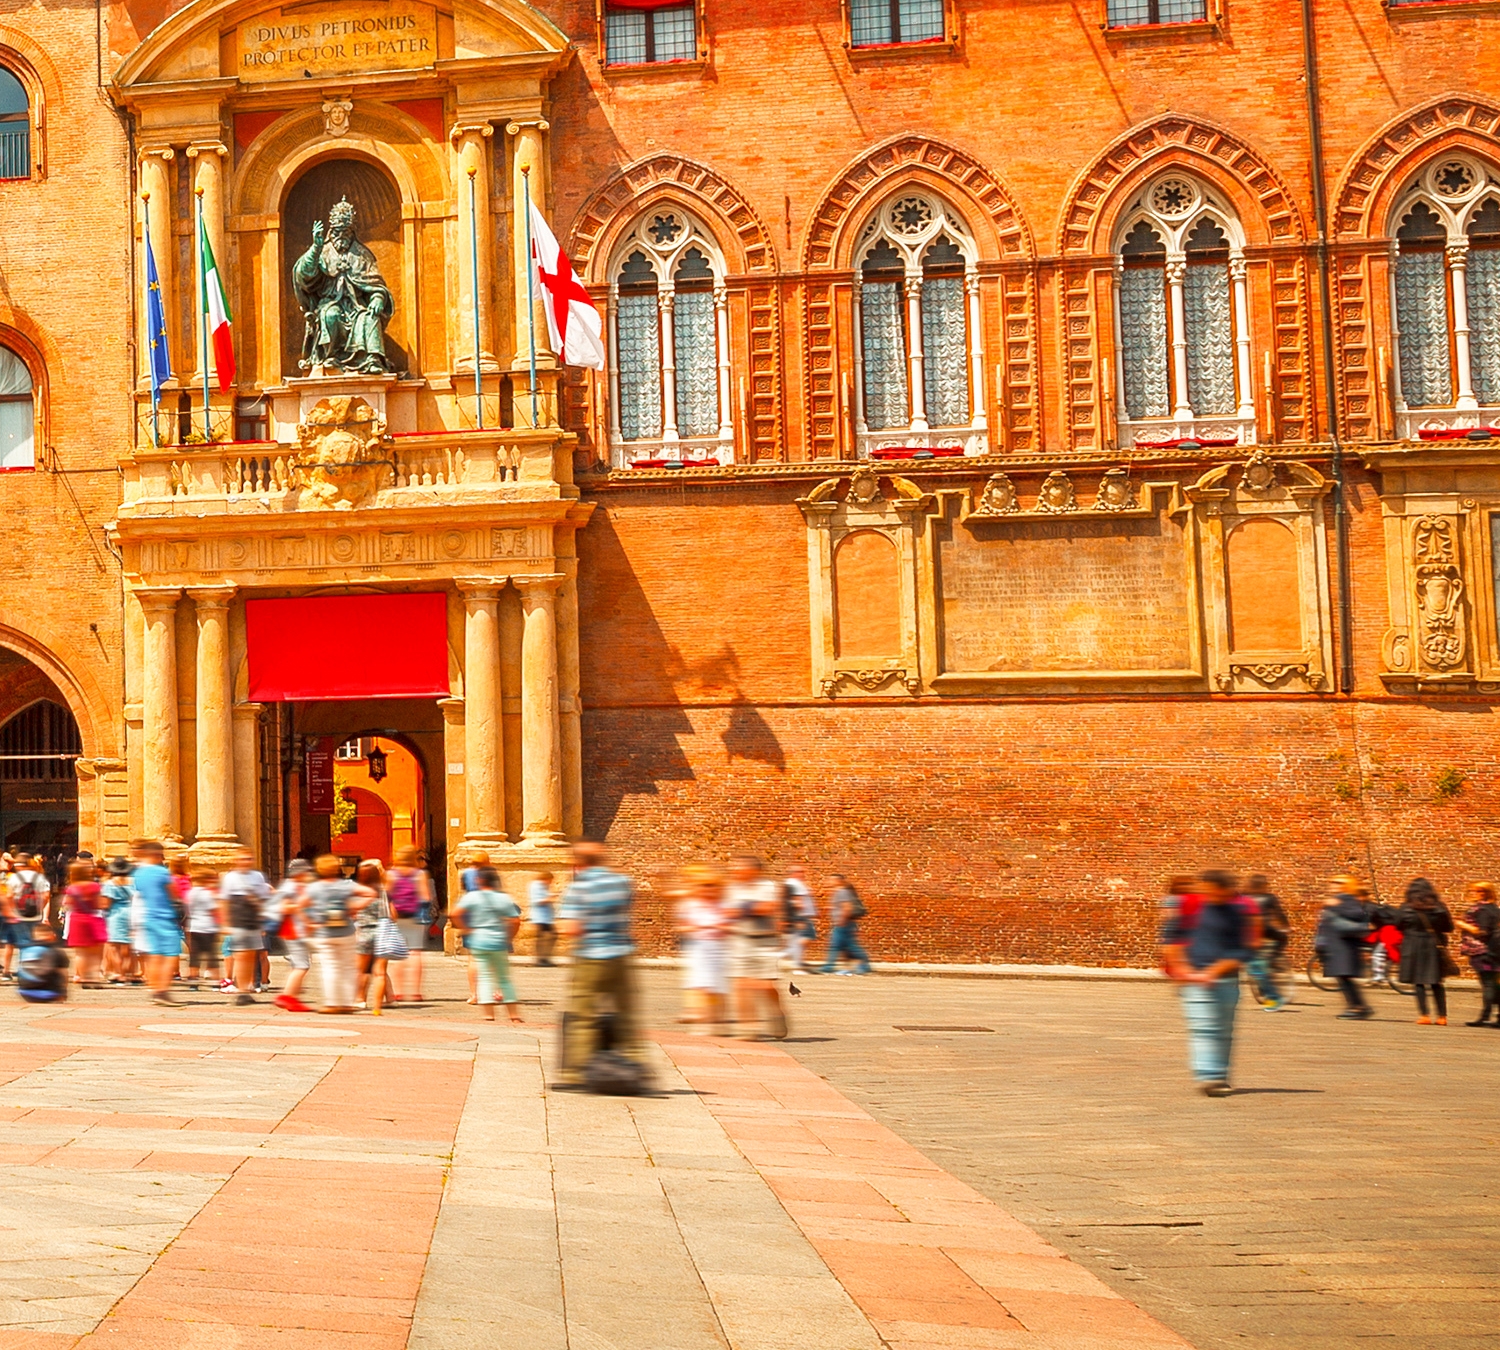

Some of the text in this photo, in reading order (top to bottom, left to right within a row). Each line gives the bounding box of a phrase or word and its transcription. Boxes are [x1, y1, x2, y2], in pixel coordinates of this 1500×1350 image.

[258, 14, 416, 42] DIVUS PETRONIUS
[243, 37, 430, 67] PROTECTOR ET PATER
